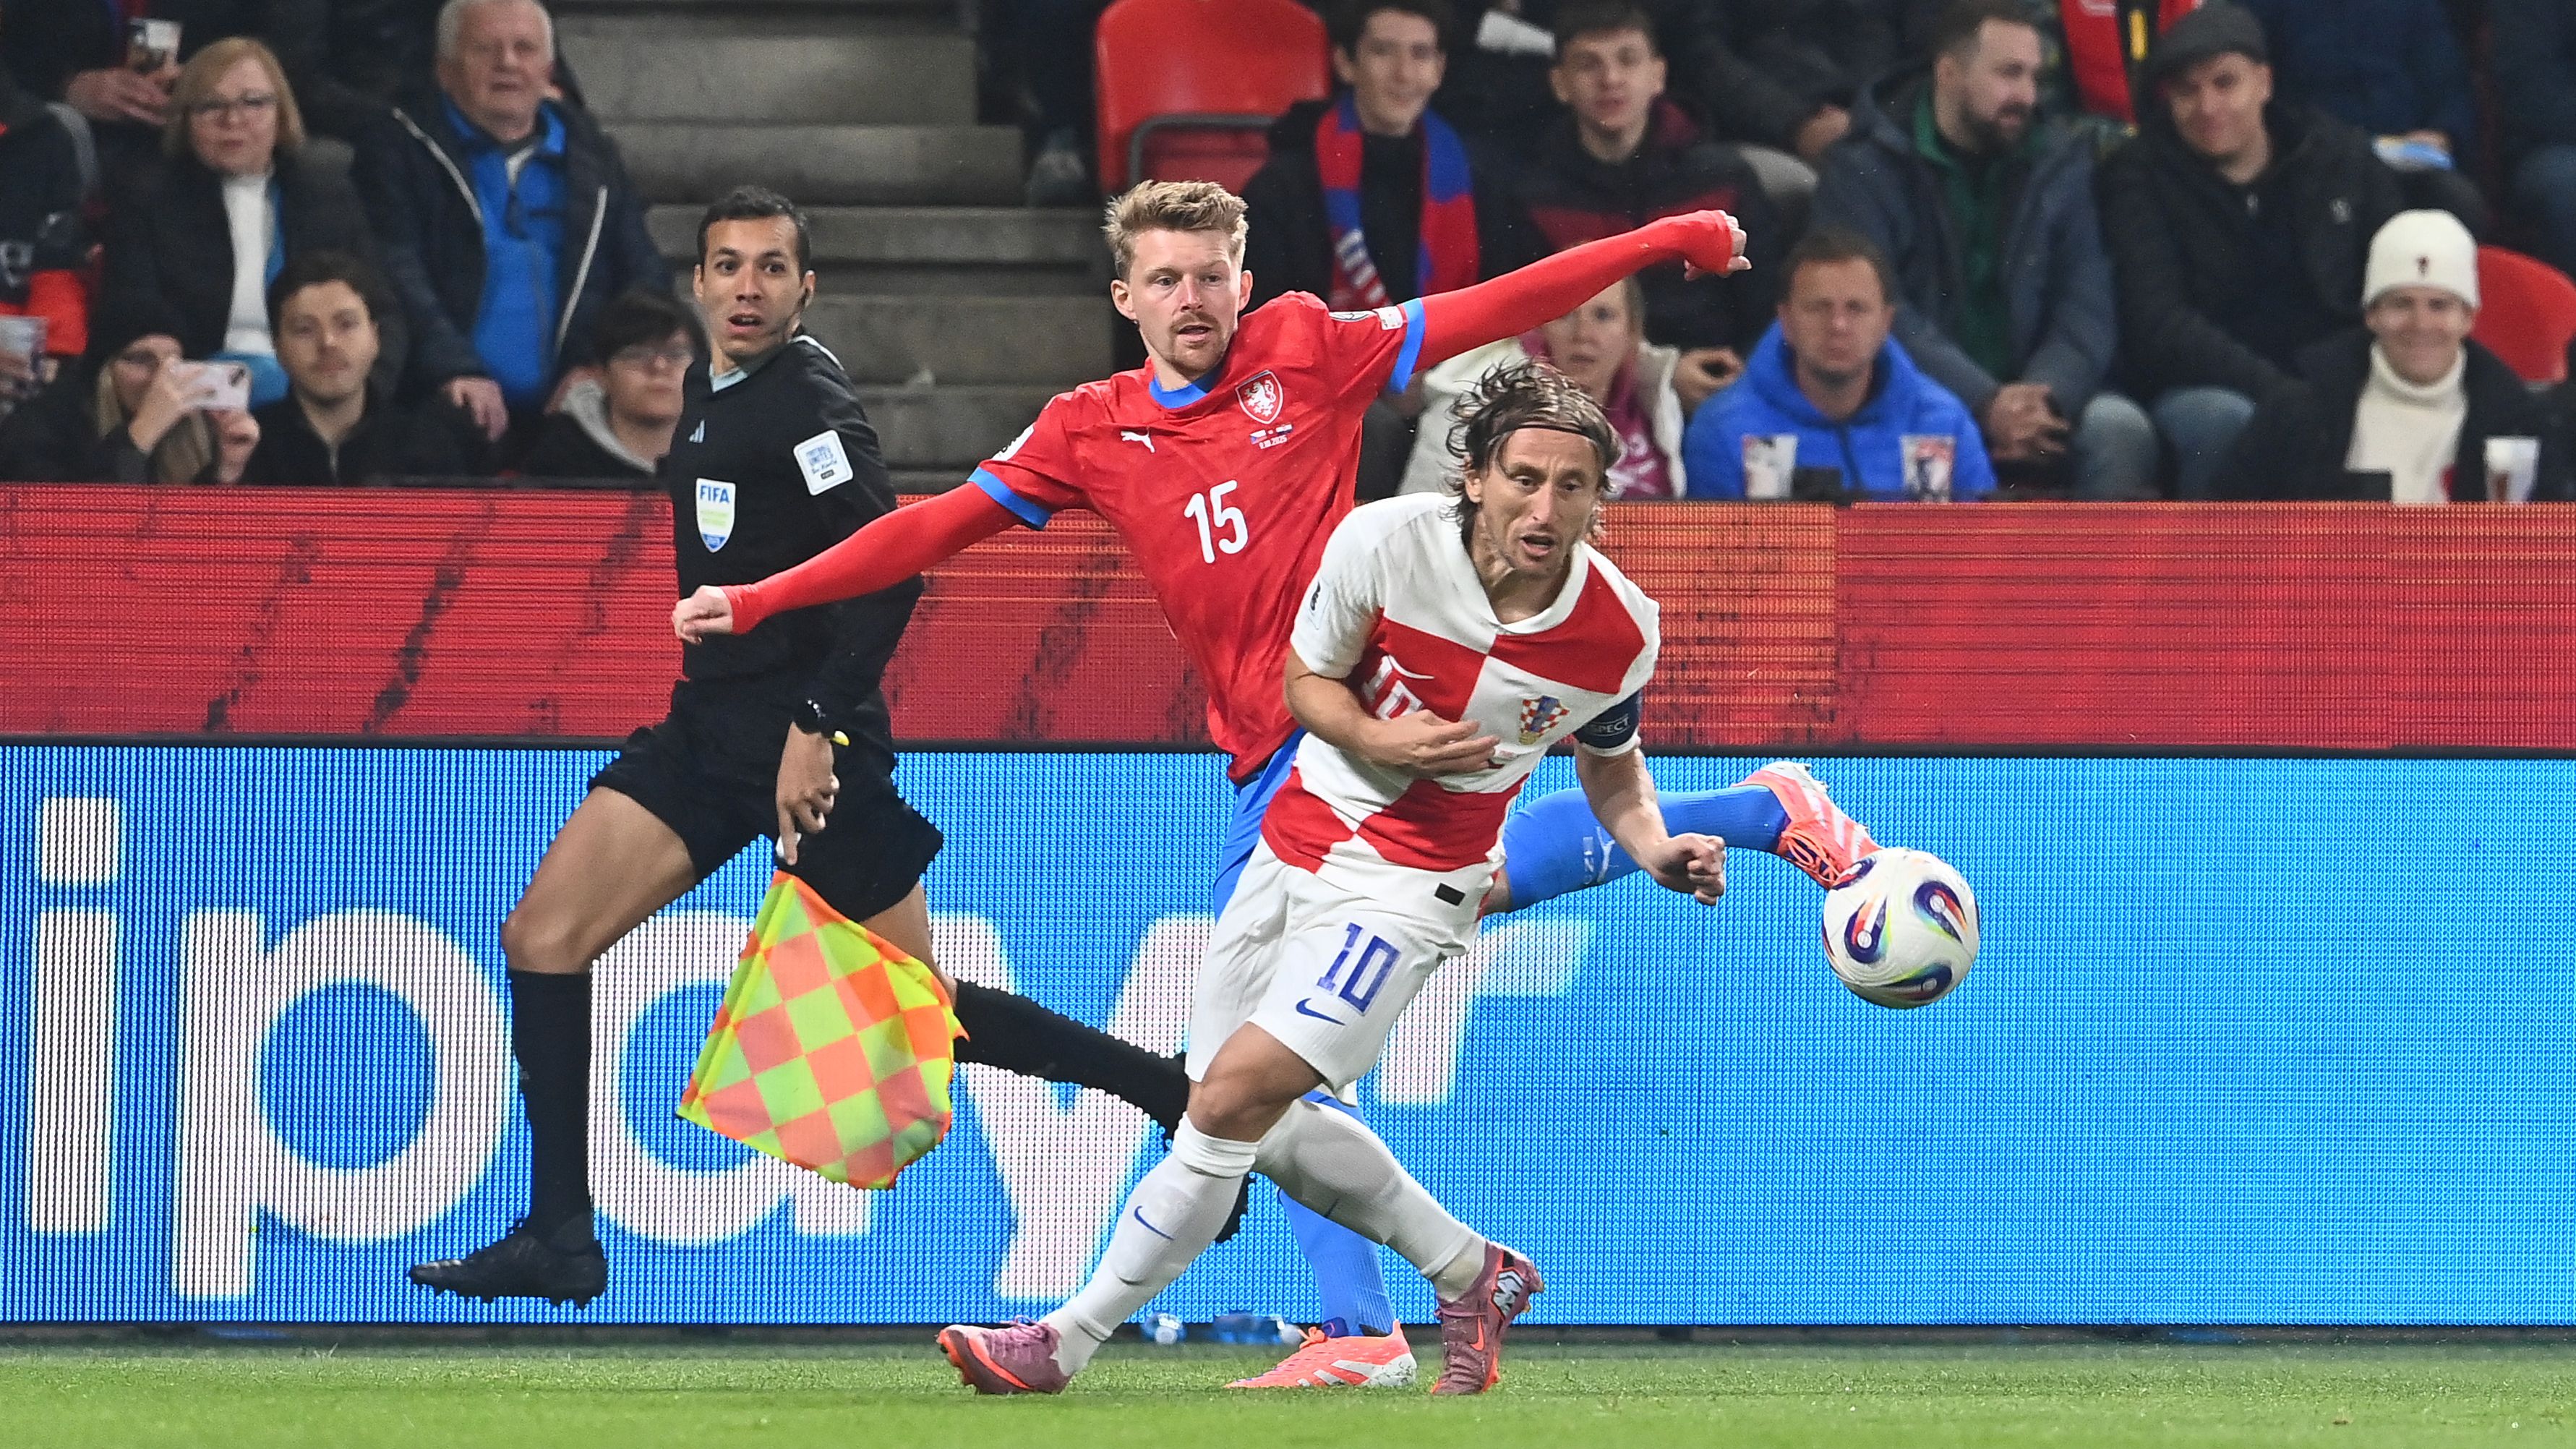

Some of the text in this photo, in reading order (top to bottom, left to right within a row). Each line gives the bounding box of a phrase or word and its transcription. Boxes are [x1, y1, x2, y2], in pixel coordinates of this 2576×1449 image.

[700, 485, 729, 503] FIFA
[1184, 479, 1249, 565] 15
[1590, 717, 1630, 733] SPECT
[1317, 922, 1402, 1016] 10
